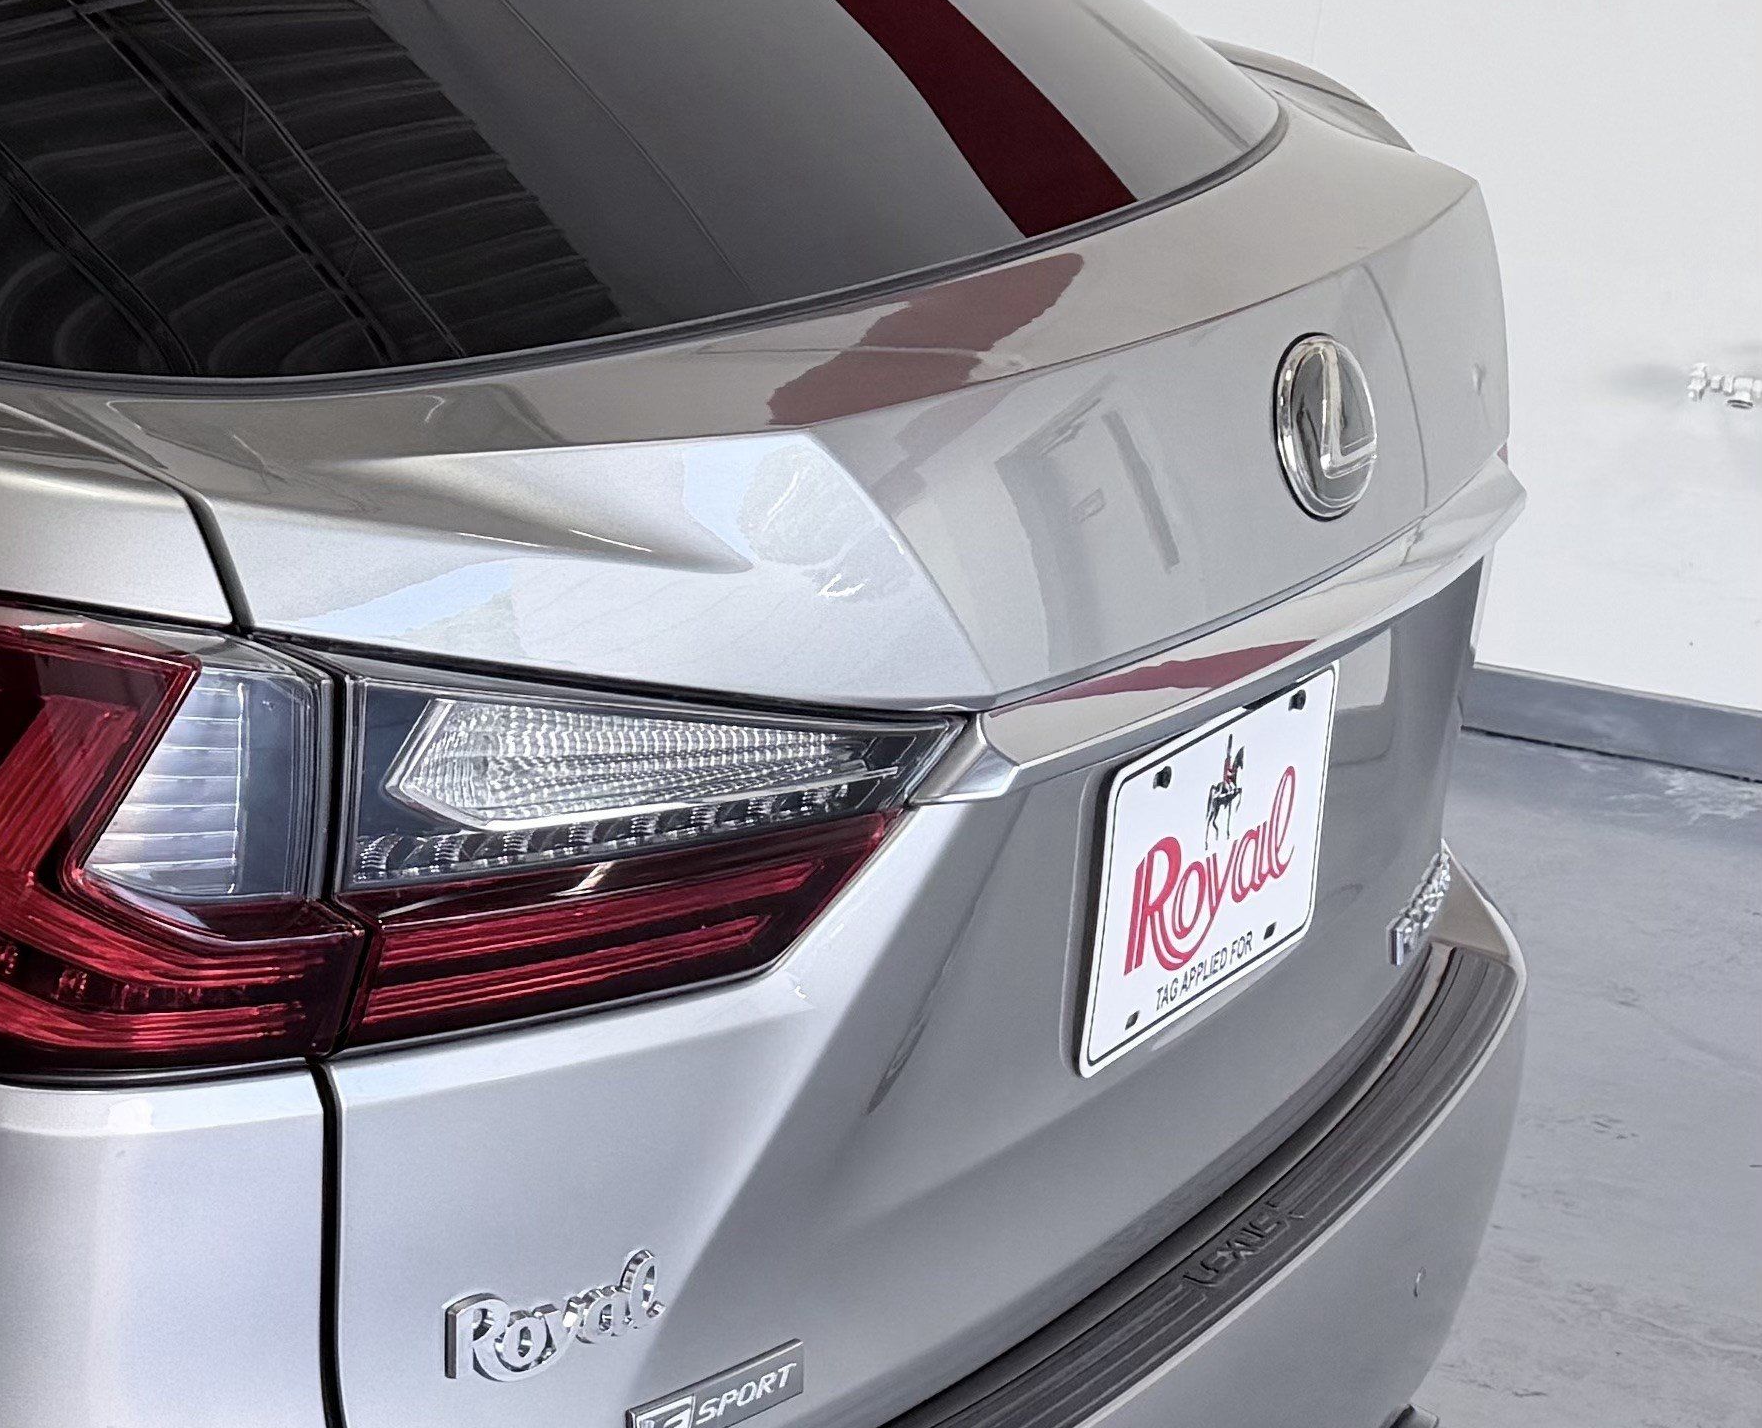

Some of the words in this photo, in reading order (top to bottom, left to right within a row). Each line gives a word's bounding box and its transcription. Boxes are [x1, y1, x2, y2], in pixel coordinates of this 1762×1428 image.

[1123, 765, 1296, 975] Royal
[1156, 977, 1179, 1011] TAG
[1179, 946, 1228, 997] APPLIED
[1229, 930, 1253, 966] FOR
[443, 1247, 666, 1383] Royal
[694, 1362, 798, 1426] SPORT
